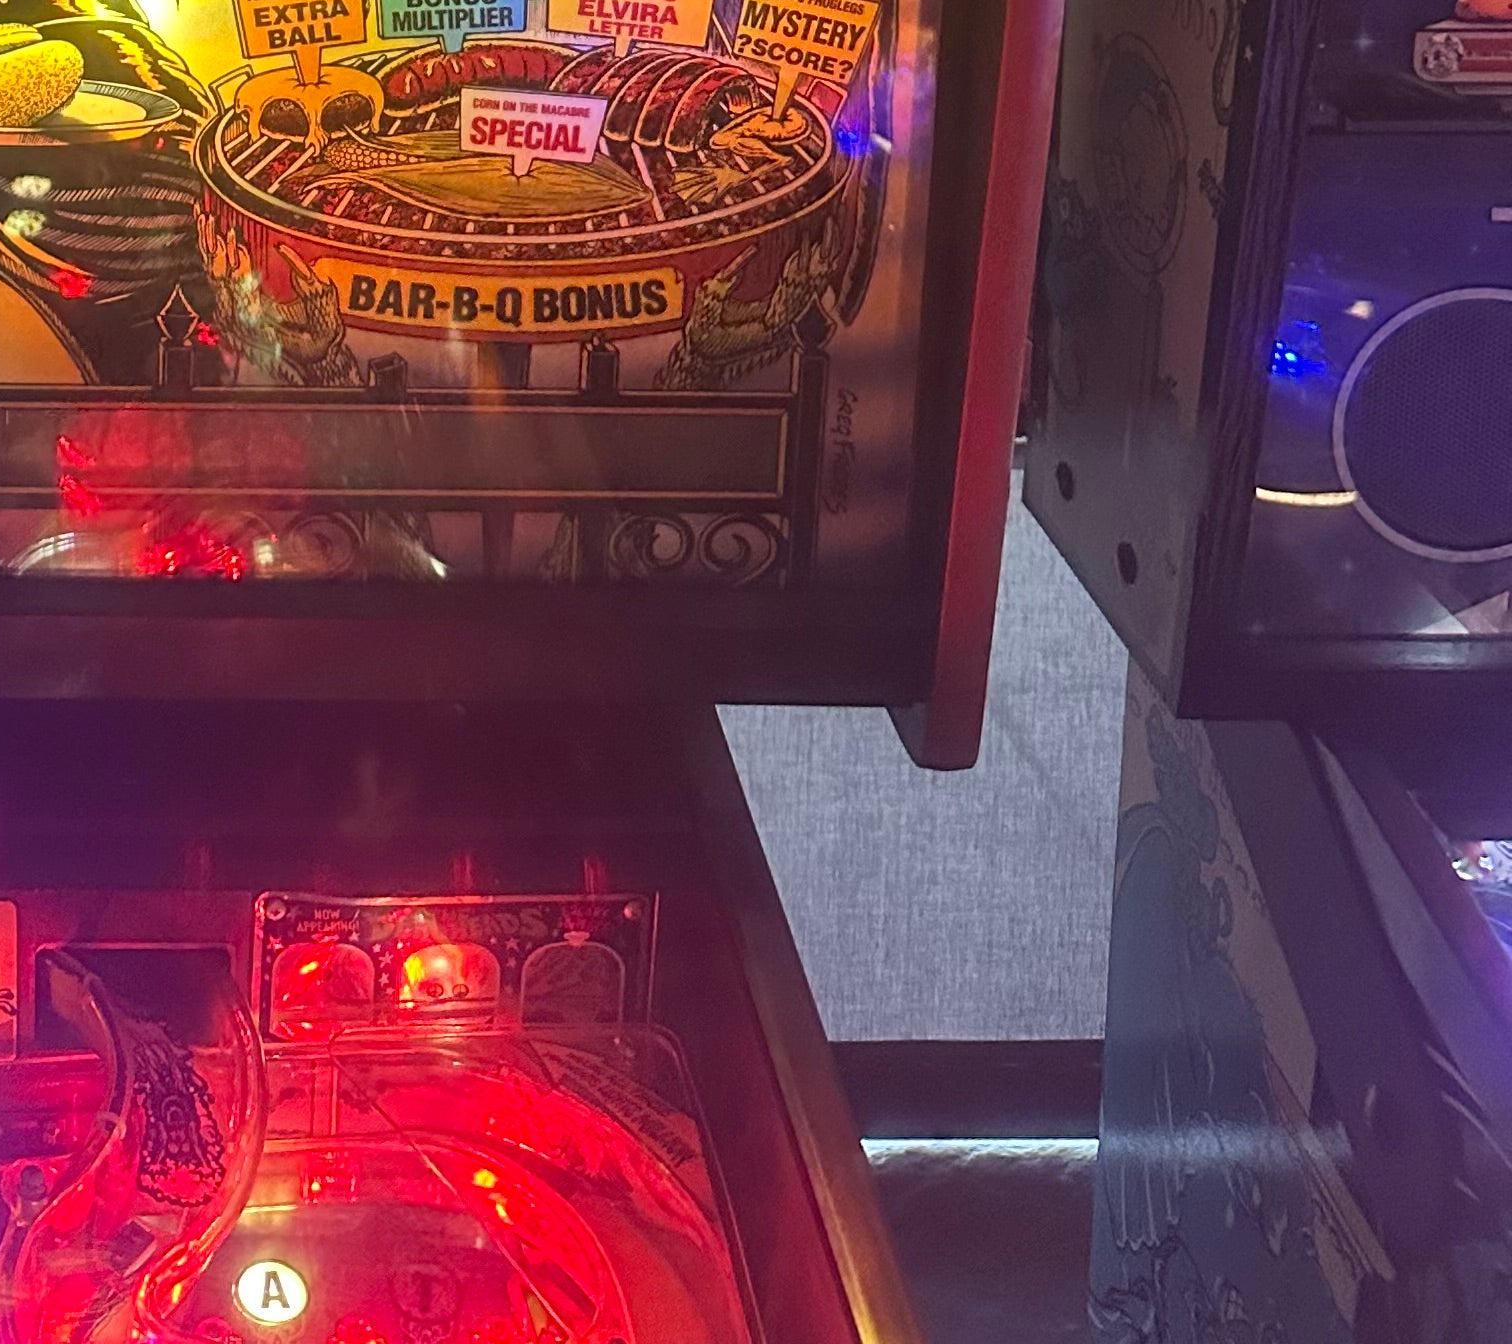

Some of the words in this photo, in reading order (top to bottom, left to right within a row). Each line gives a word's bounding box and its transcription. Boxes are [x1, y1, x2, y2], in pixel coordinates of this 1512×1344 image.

[392, 7, 513, 32] MULTIPLIER
[588, 19, 664, 40] LETTER
[742, 0, 866, 52] MYSTERY
[267, 21, 342, 49] BALL
[736, 33, 854, 78] ?SCORE?
[472, 97, 500, 111] CORN
[503, 100, 517, 112] ON
[520, 102, 538, 113] THE
[541, 103, 591, 119] MACABRE
[469, 116, 586, 155] SPECIAL
[348, 273, 523, 328] BAR-B-Q
[533, 279, 668, 324] BONUS
[296, 918, 361, 933] APPEARING!
[313, 908, 341, 920] NOW
[260, 1270, 291, 1309] A
